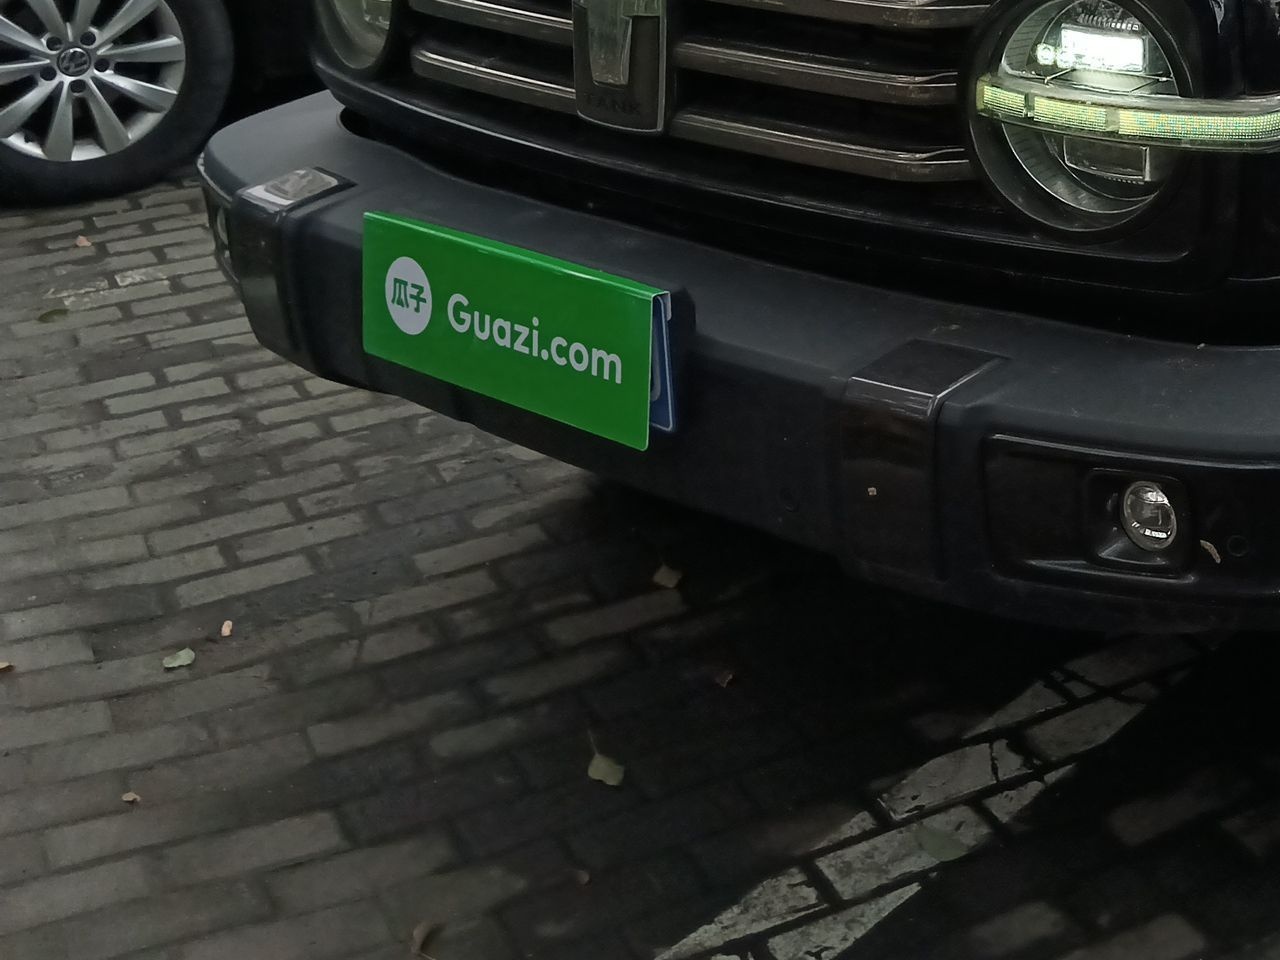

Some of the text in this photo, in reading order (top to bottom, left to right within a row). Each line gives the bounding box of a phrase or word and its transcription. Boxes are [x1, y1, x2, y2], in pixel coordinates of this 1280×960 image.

[584, 91, 641, 113] TANK
[391, 277, 427, 313] 瓜子
[447, 293, 622, 384] Guazi.com
